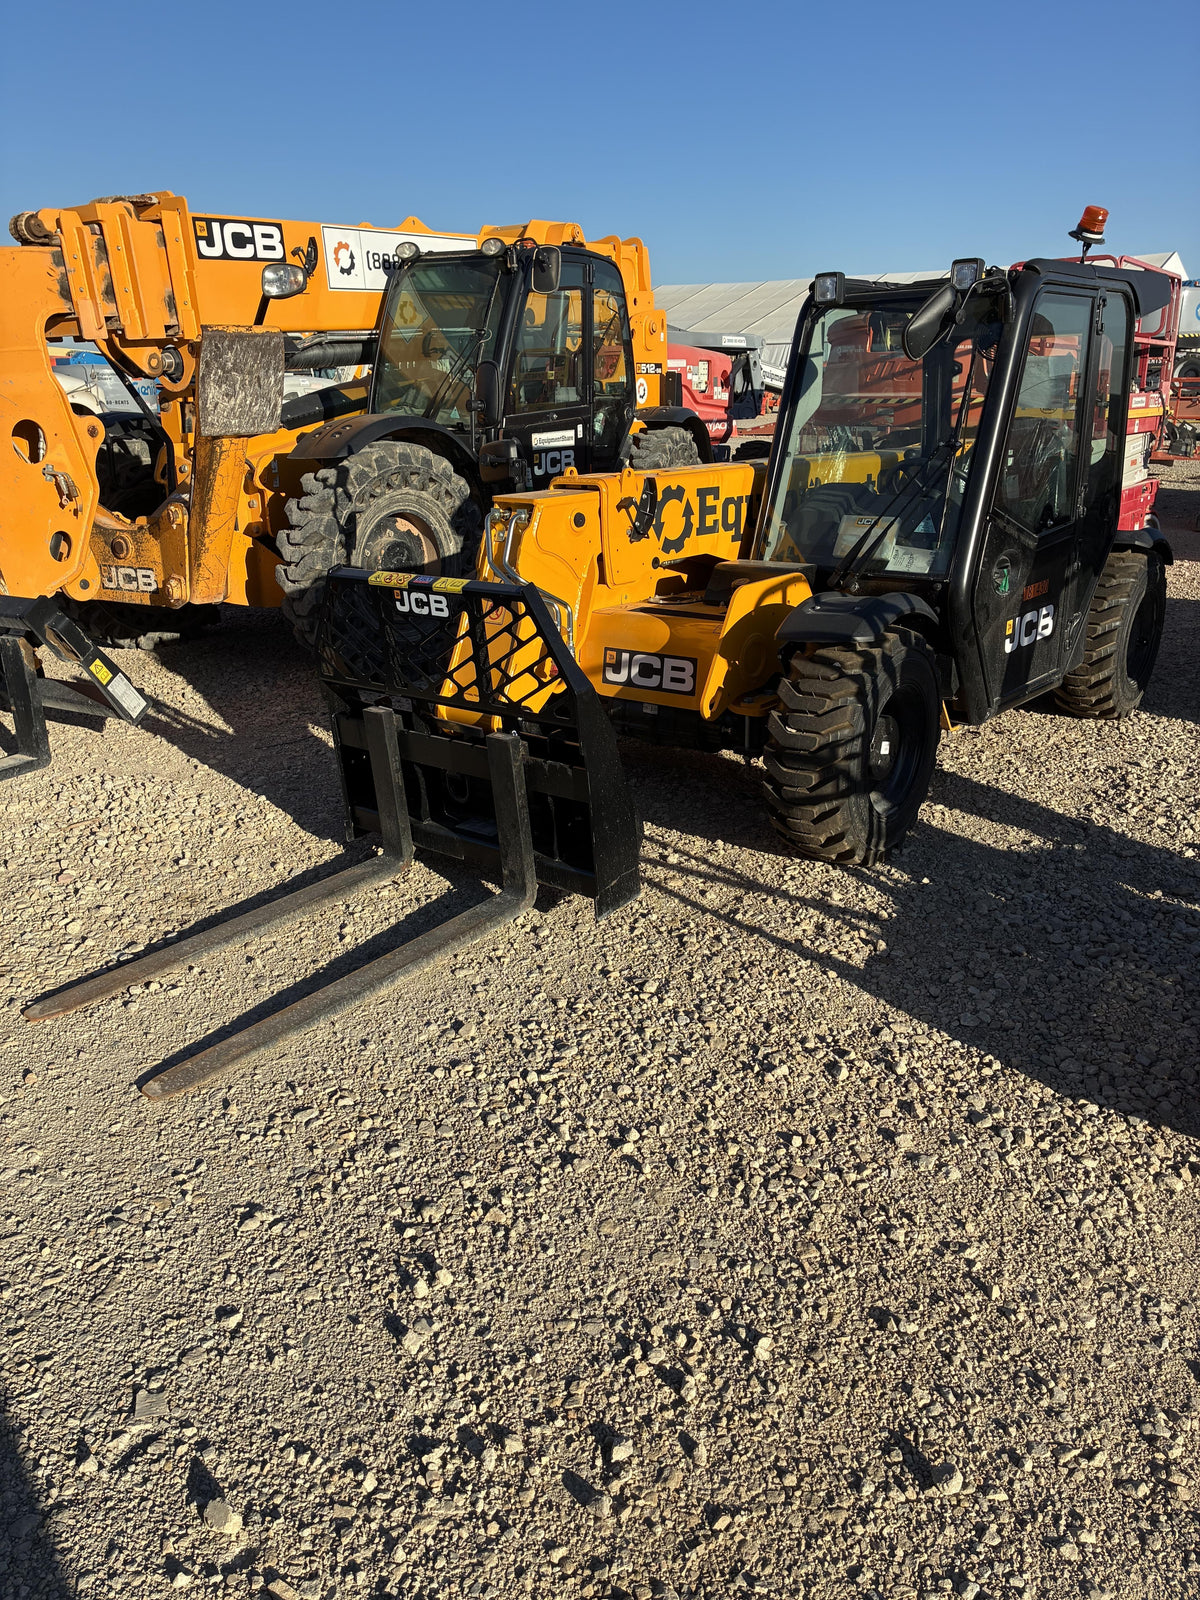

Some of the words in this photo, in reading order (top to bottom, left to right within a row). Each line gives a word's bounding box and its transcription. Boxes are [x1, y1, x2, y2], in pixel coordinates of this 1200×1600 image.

[198, 222, 284, 259] JCB
[705, 421, 728, 433] YJAC
[533, 449, 575, 476] JCB
[858, 518, 877, 526] JC
[102, 566, 158, 592] JCB
[395, 590, 450, 618] JCB
[1004, 604, 1055, 654] JCB
[605, 652, 694, 692] JCB
